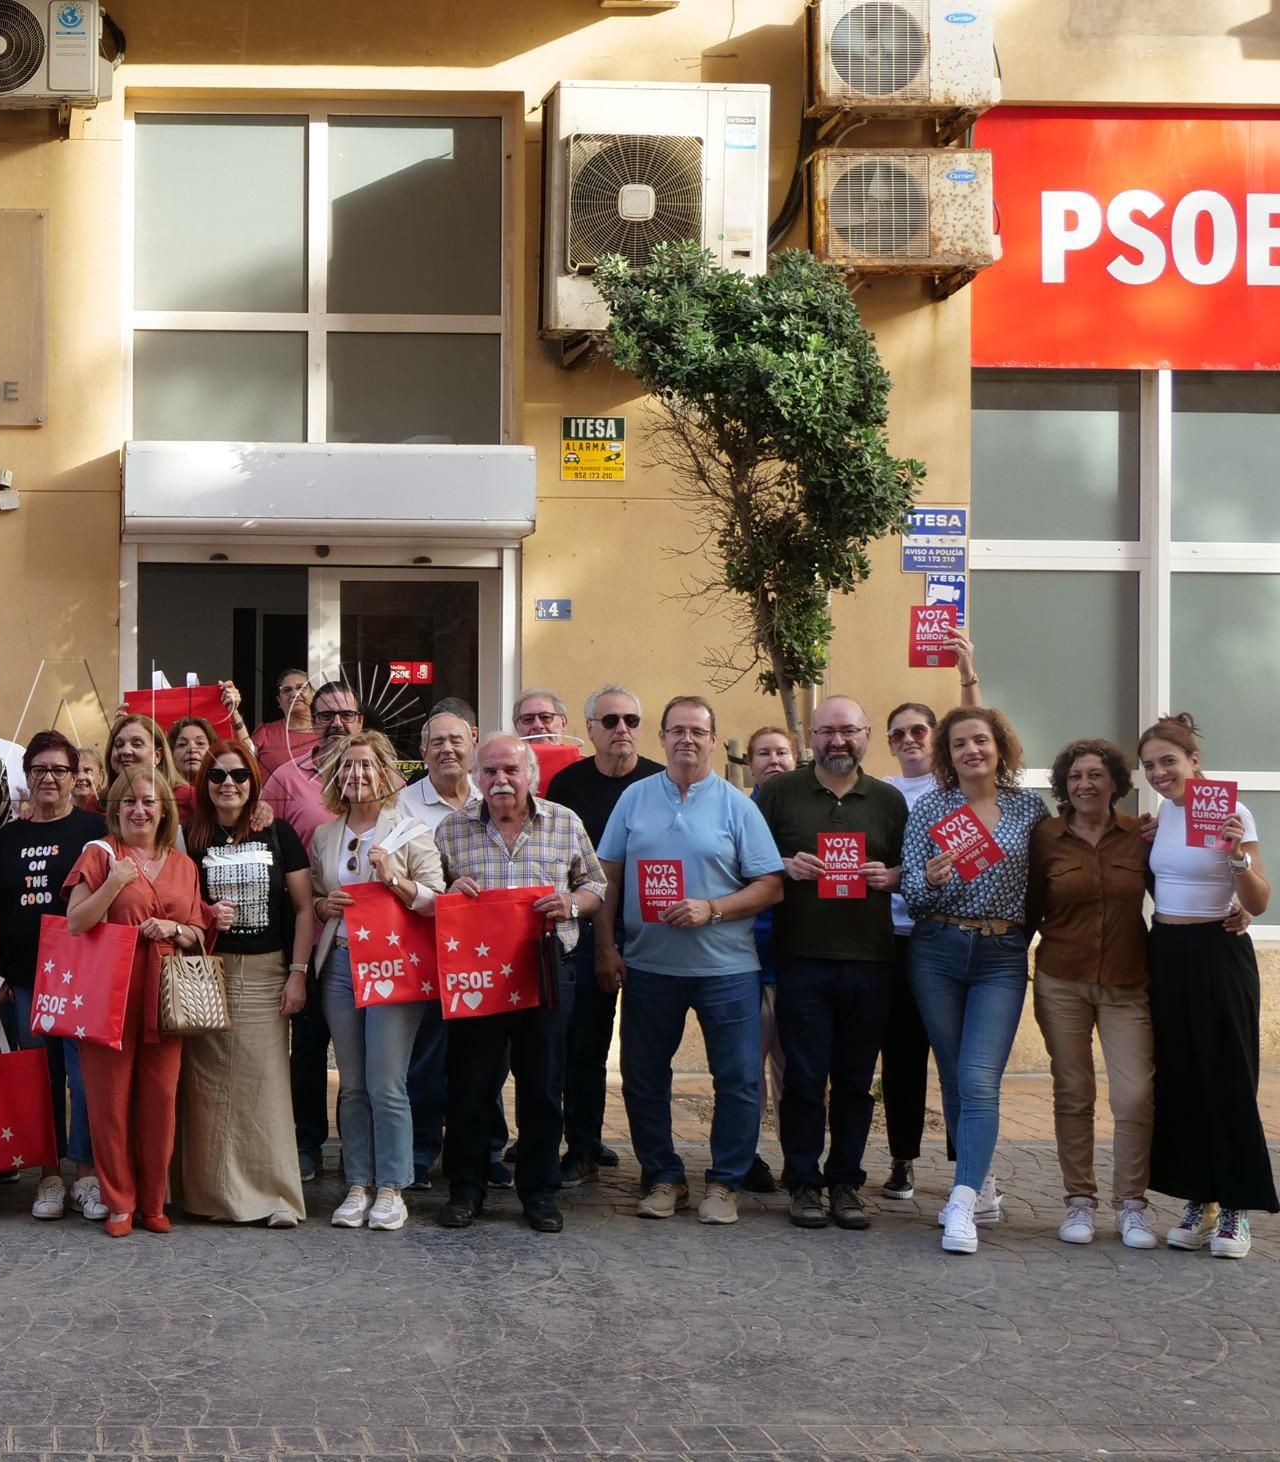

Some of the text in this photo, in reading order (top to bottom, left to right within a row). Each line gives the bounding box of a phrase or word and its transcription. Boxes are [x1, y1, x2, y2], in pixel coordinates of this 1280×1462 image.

[1041, 190, 1280, 286] PSOE
[571, 418, 617, 438] ITESA
[565, 442, 606, 452] ALARMA
[908, 514, 962, 527] ITESA
[936, 547, 964, 556] POLICÍA
[928, 575, 965, 583] ITESA
[548, 602, 559, 617] 4
[917, 610, 950, 620] VOTA
[916, 619, 950, 633] MÁS
[916, 633, 949, 641] EUROPA
[391, 671, 410, 679] PSOE
[394, 762, 424, 770] TESA
[1192, 786, 1229, 798] VOTA
[1192, 797, 1229, 812] MÁS
[1192, 811, 1226, 819] EUROPA
[936, 813, 970, 836] VOTA
[945, 822, 978, 850] MÁS
[824, 838, 858, 848] VOTA
[952, 833, 984, 856] EUROPA
[21, 844, 59, 858] FOCUS
[824, 848, 859, 862] MÁS
[29, 860, 47, 871] ON
[644, 865, 677, 874] VOTA
[24, 875, 48, 888] THE
[645, 874, 678, 889] MÁS
[645, 888, 677, 896] EUROPA
[20, 892, 52, 906] GOOD
[358, 959, 405, 980] PSOE
[446, 970, 494, 991] PSOE
[36, 993, 68, 1015] PSOE
